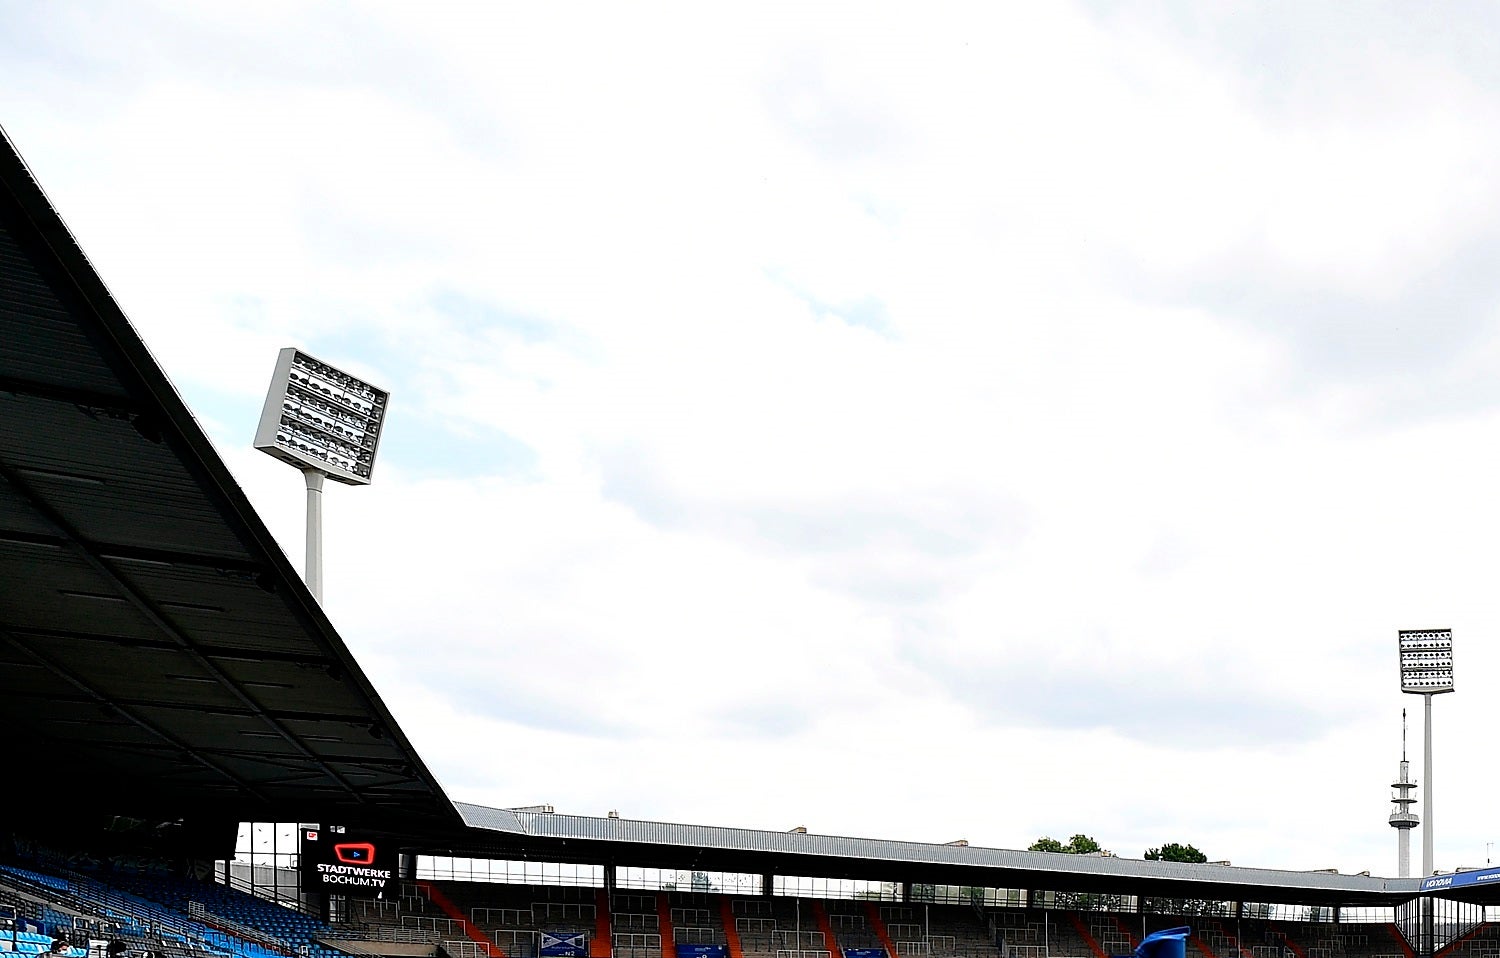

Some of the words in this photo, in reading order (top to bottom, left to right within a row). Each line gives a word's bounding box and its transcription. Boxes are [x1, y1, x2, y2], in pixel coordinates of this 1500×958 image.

[317, 863, 391, 879] STADTWERKE
[322, 874, 386, 888] BOCHUM.TV
[1426, 877, 1453, 888] VONOVIA
